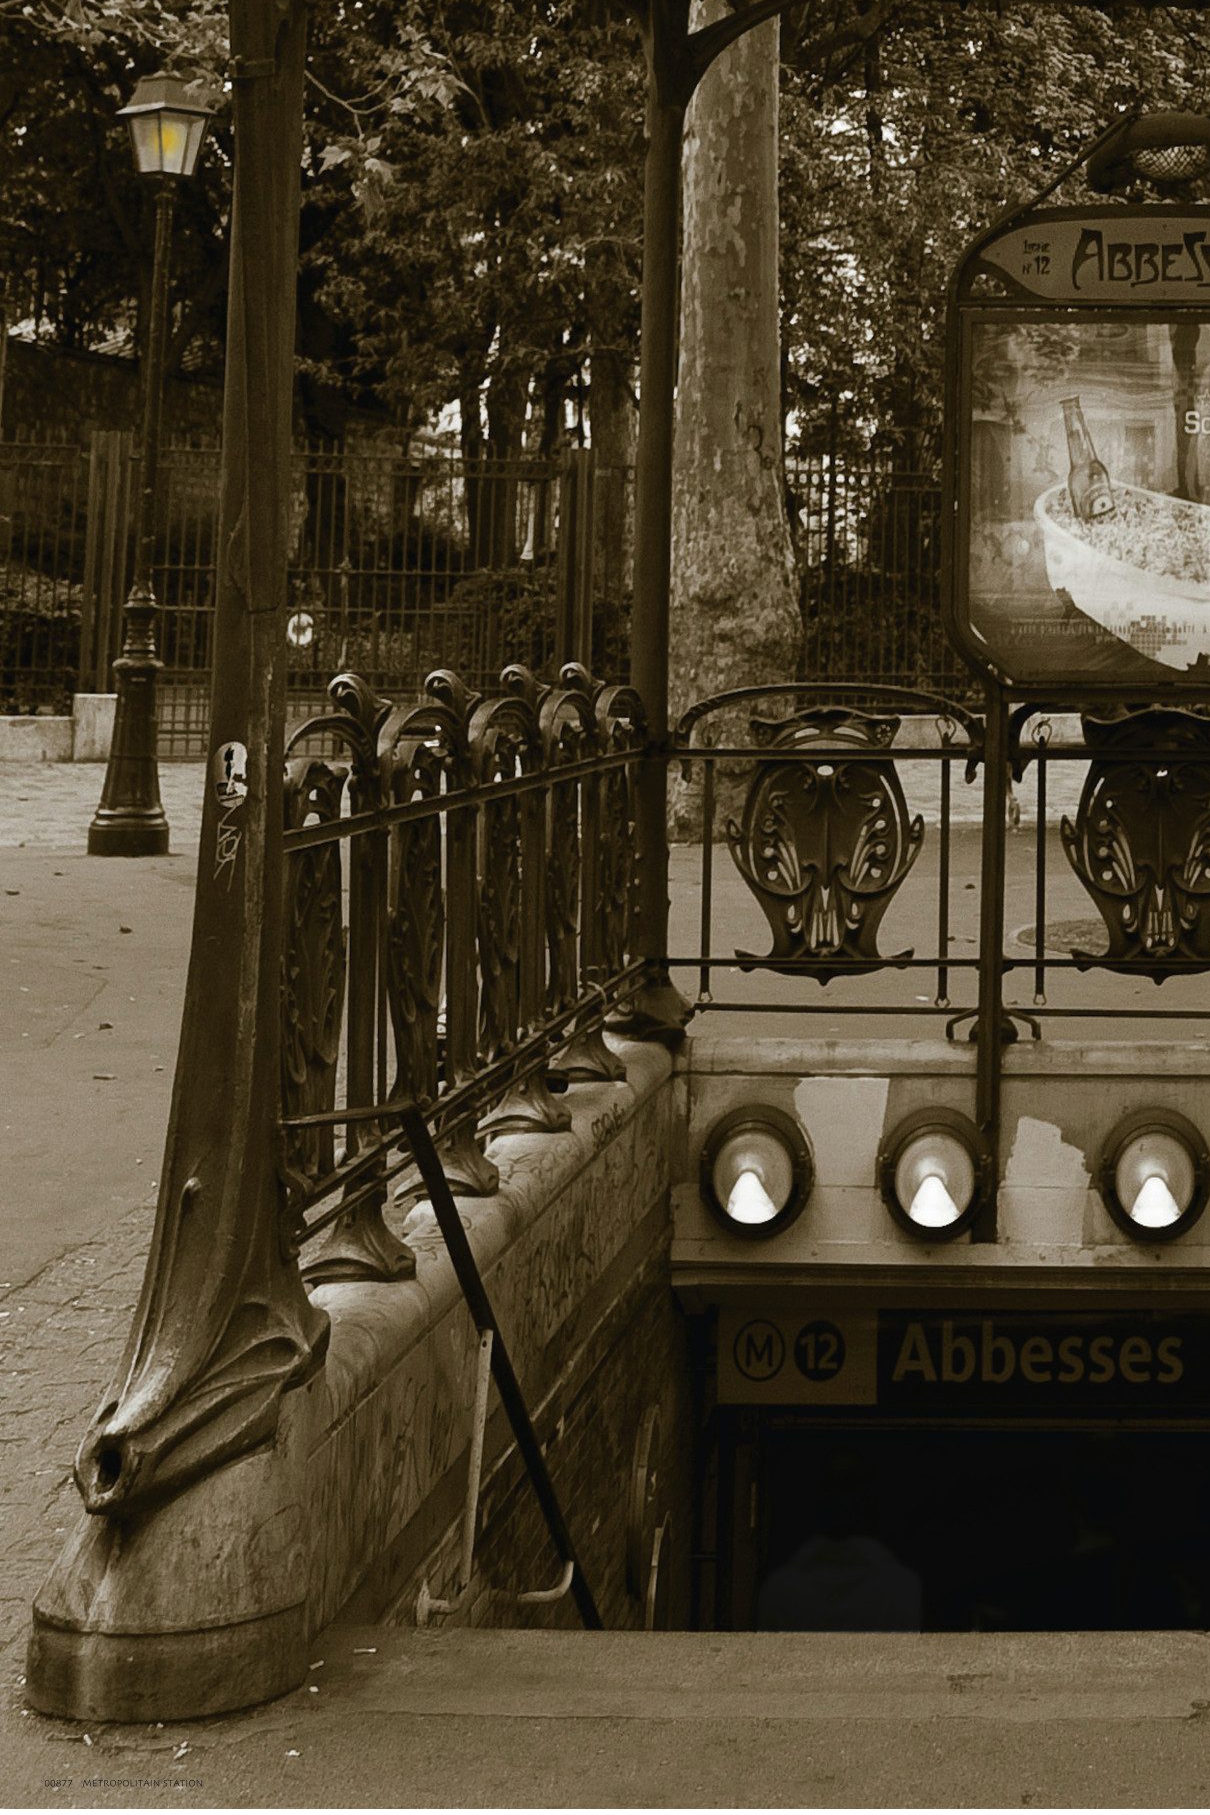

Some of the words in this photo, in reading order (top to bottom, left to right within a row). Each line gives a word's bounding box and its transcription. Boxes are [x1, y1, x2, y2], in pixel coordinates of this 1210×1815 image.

[1034, 255, 1051, 275] 12
[743, 1331, 776, 1369] M
[800, 1330, 840, 1372] 12
[891, 1320, 1186, 1385] Abbesses
